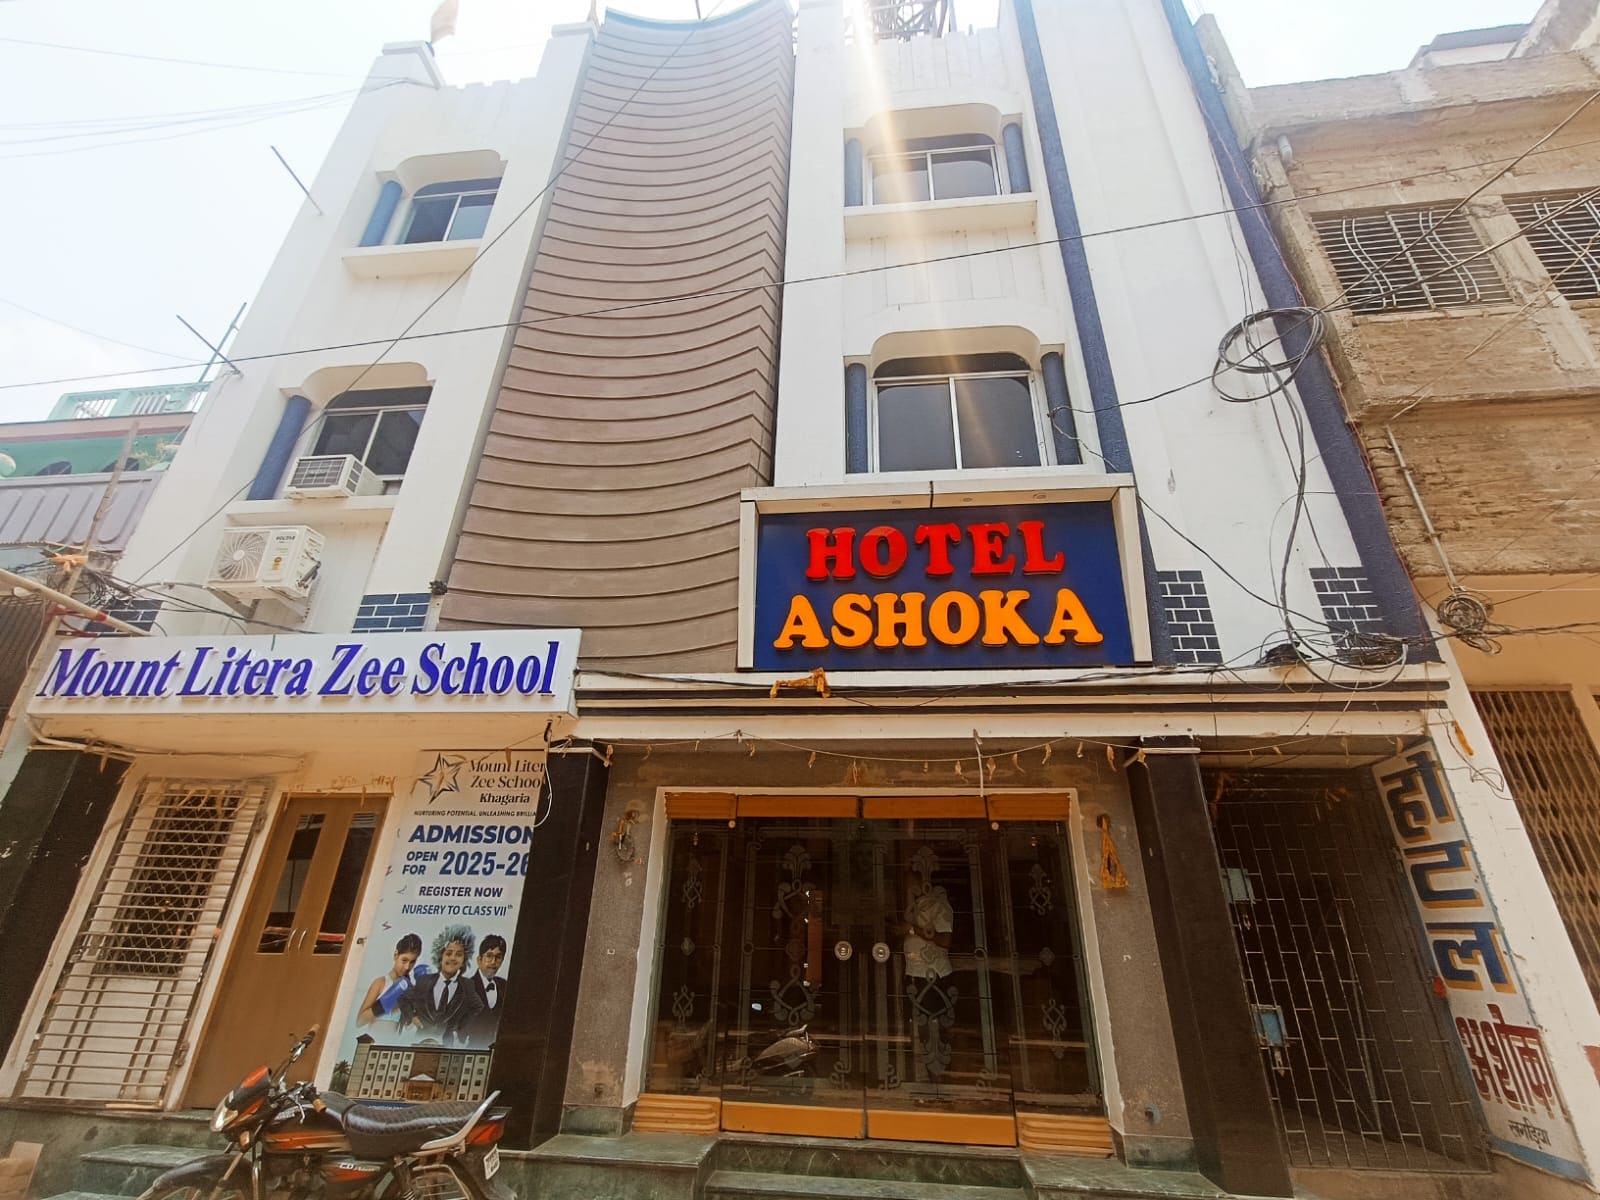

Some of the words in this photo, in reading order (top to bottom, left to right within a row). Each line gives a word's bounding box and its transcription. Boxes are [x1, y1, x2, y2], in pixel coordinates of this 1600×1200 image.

[805, 520, 1066, 579] HOTEL
[773, 588, 1104, 650] ASHOKA
[36, 648, 182, 697] Mount
[176, 646, 314, 698] Litera
[317, 644, 405, 695] Zee
[410, 641, 560, 695] School
[469, 760, 511, 772] Mount
[470, 775, 495, 788] Zee
[480, 793, 530, 805] Khagaria
[408, 825, 534, 844] ADMISSION
[406, 851, 438, 861] OPEN
[402, 865, 426, 875] FOR
[419, 886, 471, 897] REGISTER
[474, 887, 503, 898] NOW
[402, 904, 445, 915] NURSERY
[447, 905, 460, 915] TO
[462, 905, 492, 916] CLASS
